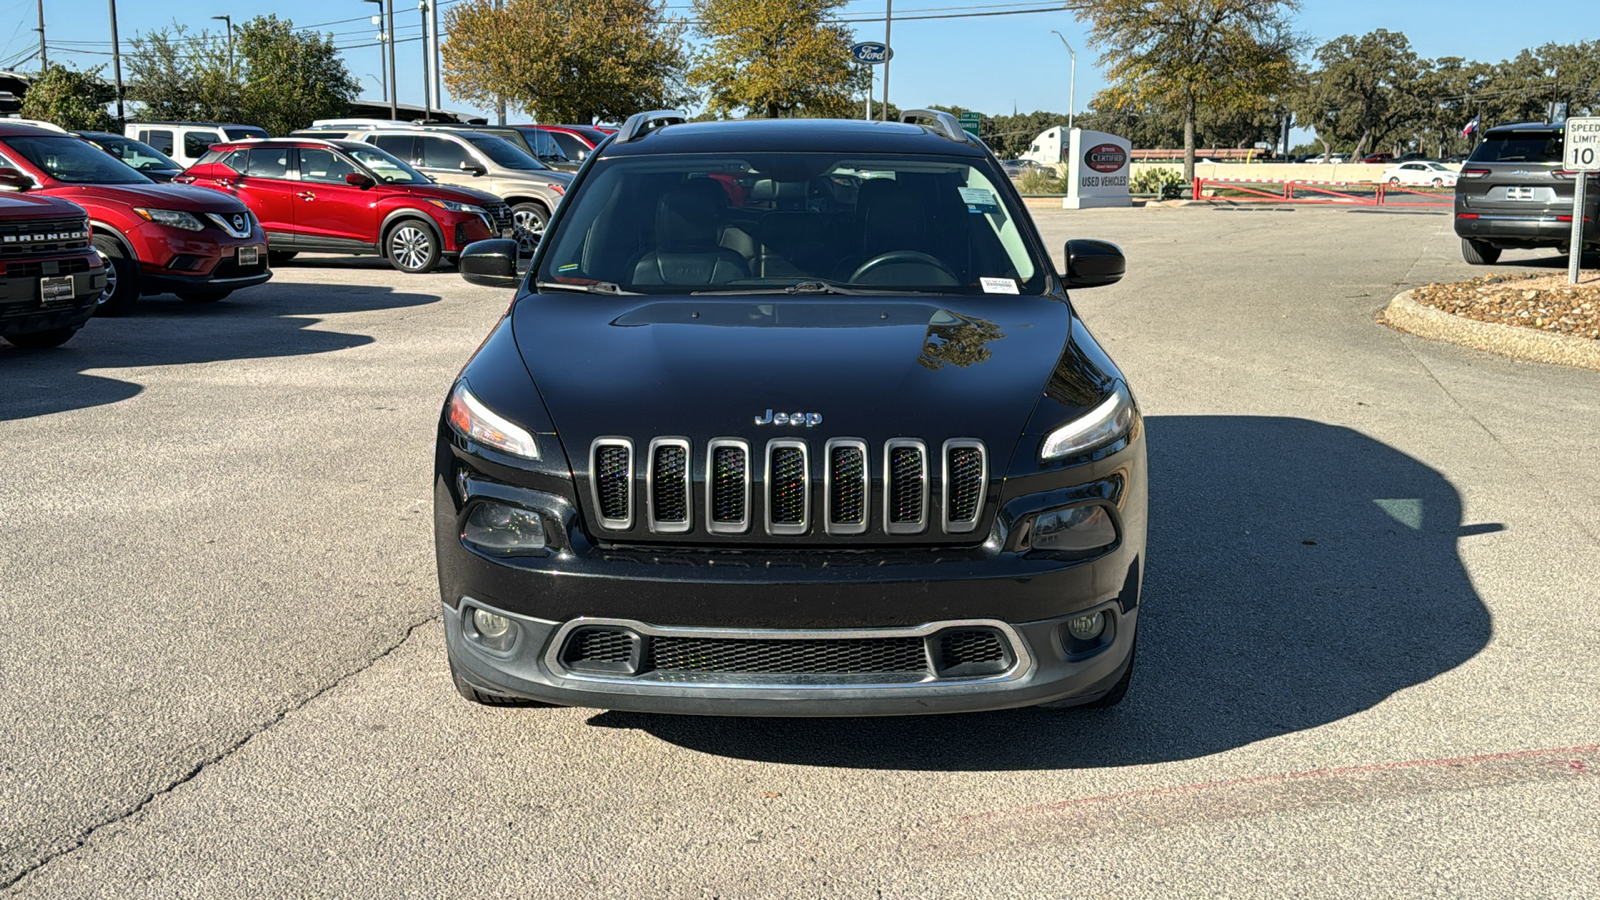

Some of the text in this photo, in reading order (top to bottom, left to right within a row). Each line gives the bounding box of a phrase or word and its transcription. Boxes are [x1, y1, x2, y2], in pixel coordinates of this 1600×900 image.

[859, 46, 885, 60] Ford
[1571, 124, 1600, 132] SPEED
[1573, 135, 1597, 143] LIMIT
[1573, 147, 1594, 164] 10
[1082, 176, 1126, 187] USED VEHICLES
[3, 231, 80, 242] BRONCO
[754, 408, 823, 427] Jeep
